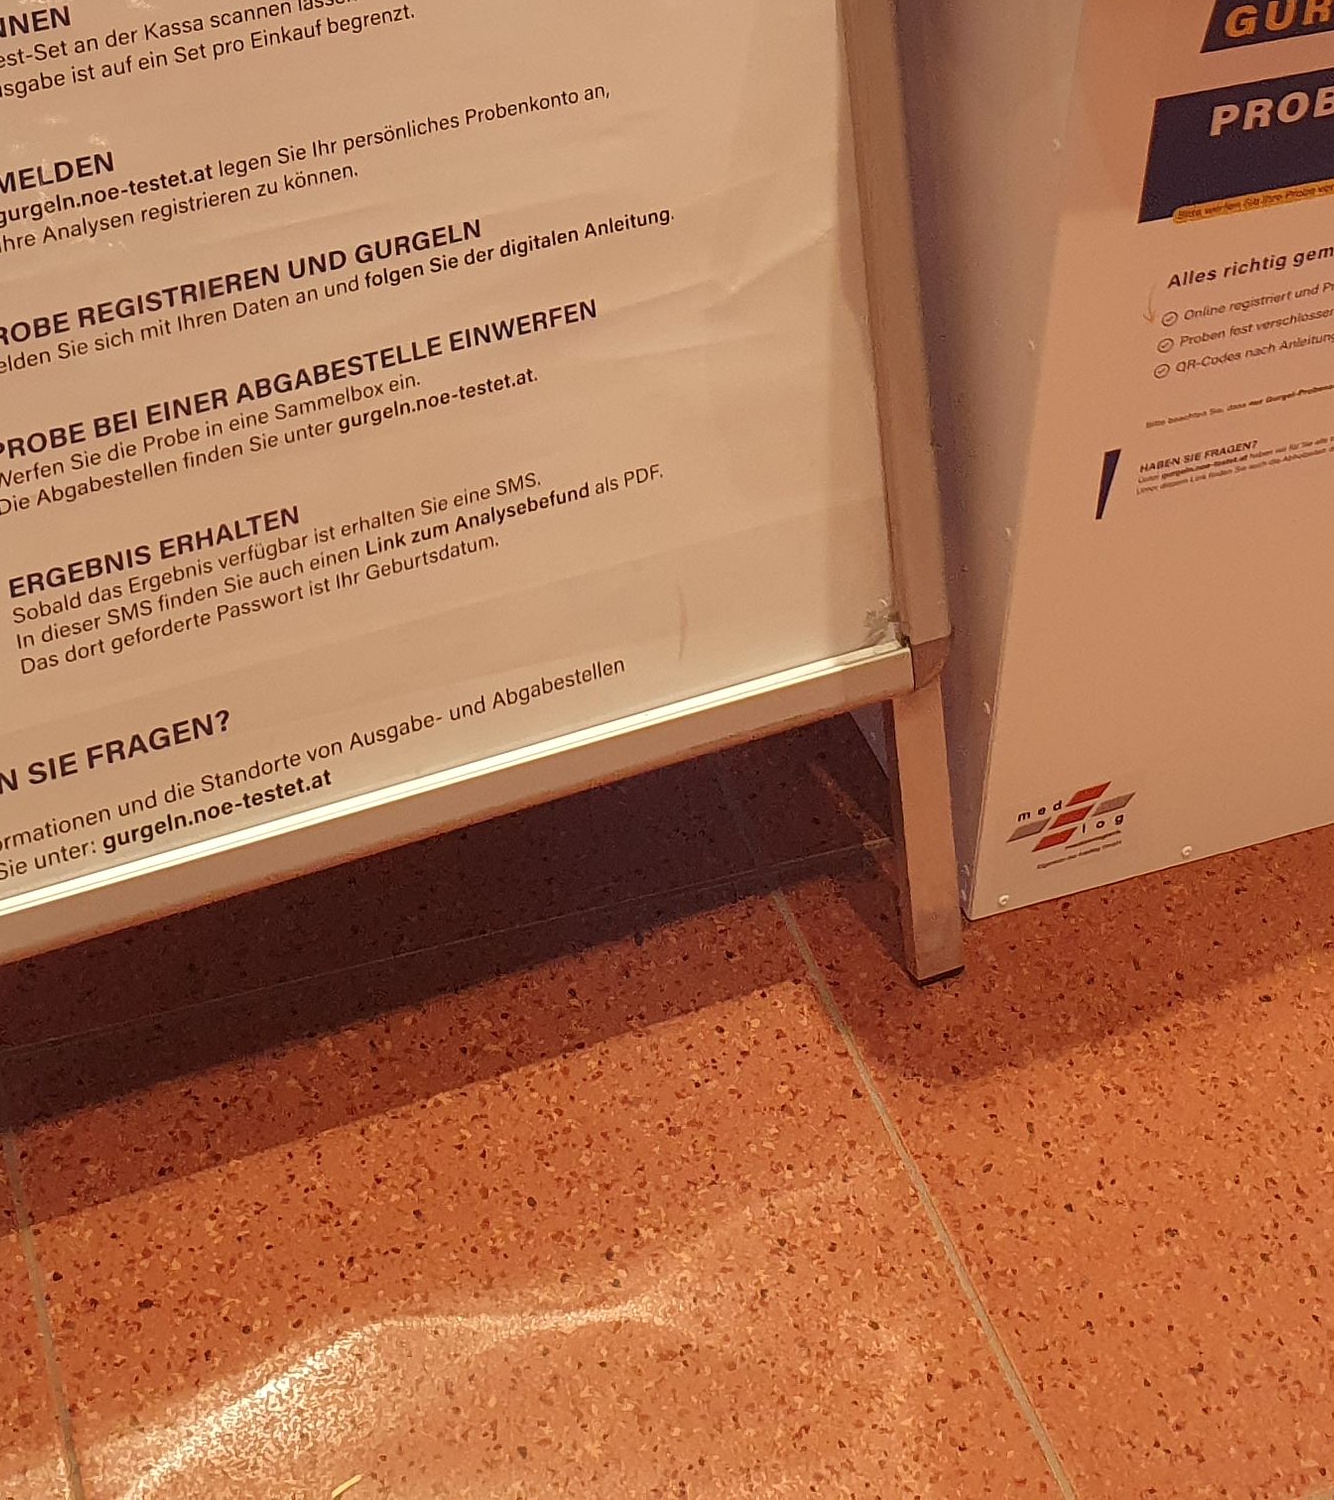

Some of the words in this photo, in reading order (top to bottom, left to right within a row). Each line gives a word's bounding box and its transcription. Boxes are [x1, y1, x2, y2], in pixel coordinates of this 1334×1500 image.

[75, 39, 98, 53] an
[106, 30, 137, 47] der
[145, 19, 203, 40] Kassa
[210, 2, 291, 27] scannen
[43, 213, 133, 243] Analysen
[142, 188, 250, 221] registrieren
[257, 182, 277, 196] zu
[284, 166, 357, 190] können.
[78, 264, 279, 327] REGISTRIEREN
[289, 251, 346, 278] UND
[355, 219, 480, 263] GURGELN
[1168, 270, 1216, 288] Alles
[1224, 255, 1286, 277] richtig
[94, 410, 137, 437] BEI
[147, 389, 228, 425] EINER
[237, 336, 442, 403] ABGABESTELLE
[450, 299, 596, 351] EINWERFEN
[1180, 331, 1225, 346] Proben
[1230, 324, 1252, 336] fest
[9, 546, 151, 598] ERGEBNIS
[160, 506, 298, 559] ERHALTEN
[29, 752, 77, 784] SIE
[87, 710, 229, 769] FRAGEN?
[35, 841, 95, 869] unter:
[103, 770, 331, 853] gurgeln.noe-testet.at
